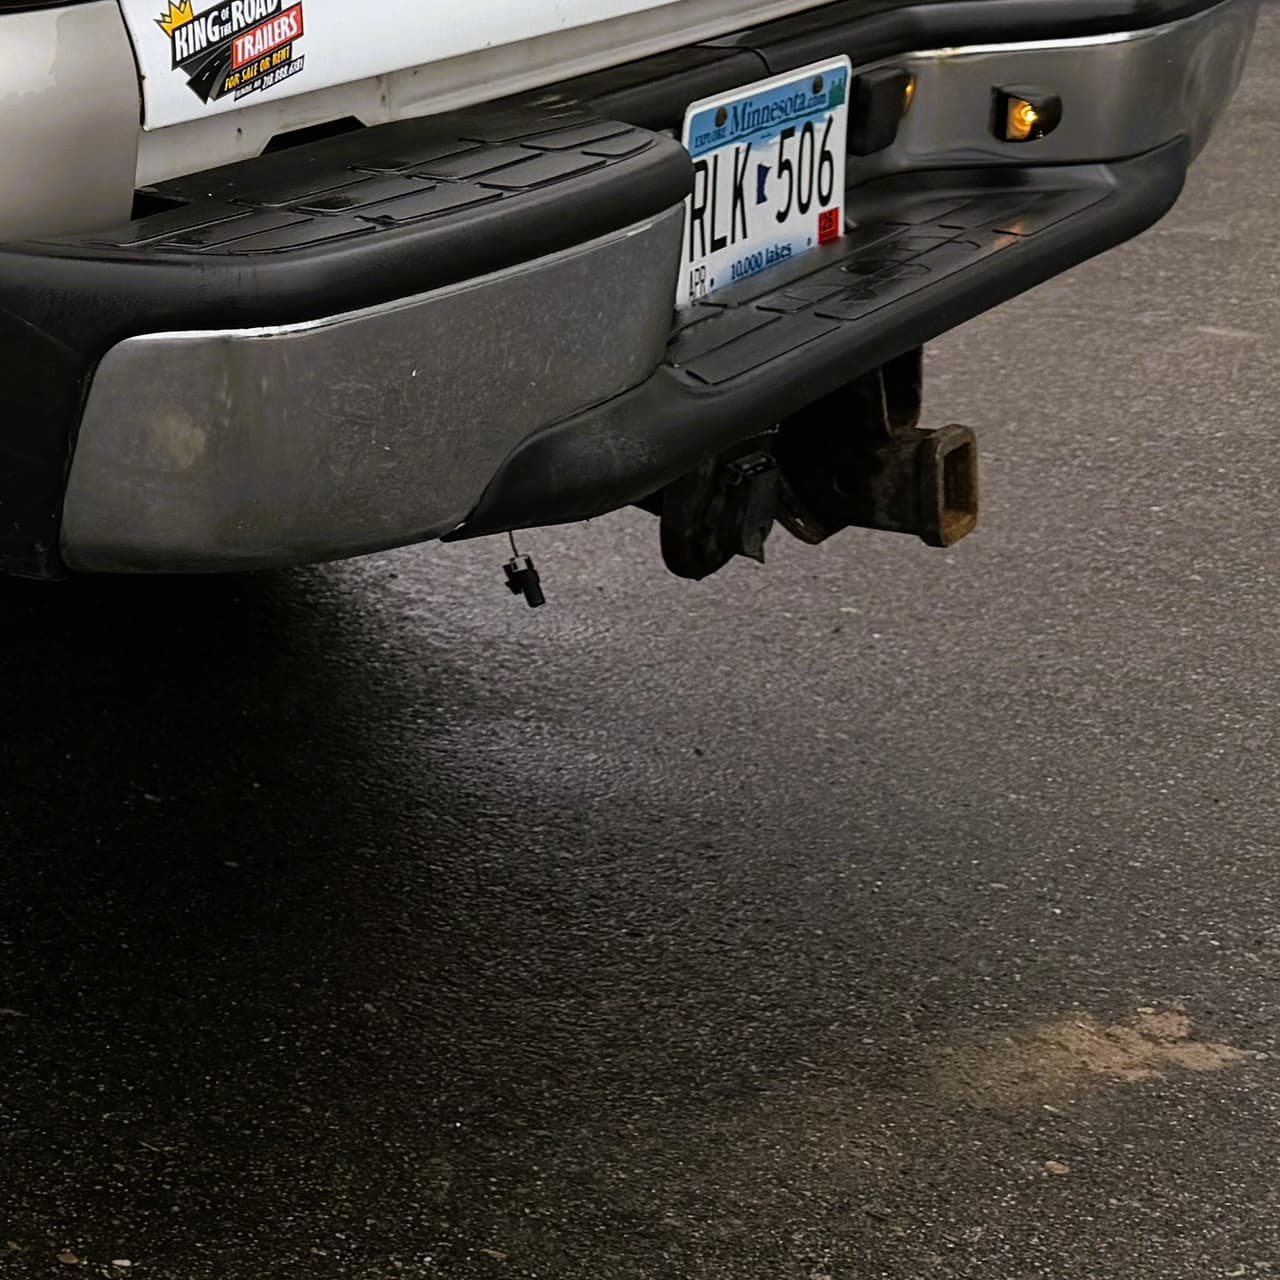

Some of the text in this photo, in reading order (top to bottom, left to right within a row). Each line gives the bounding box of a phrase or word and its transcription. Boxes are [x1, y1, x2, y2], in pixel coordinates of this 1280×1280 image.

[220, 6, 231, 20] OF
[220, 20, 232, 38] THE
[174, 9, 220, 61] KING
[235, 10, 299, 64] TRAILERS
[224, 73, 240, 91] FOR
[241, 63, 259, 83] SALE
[690, 115, 834, 262] RLK 506
